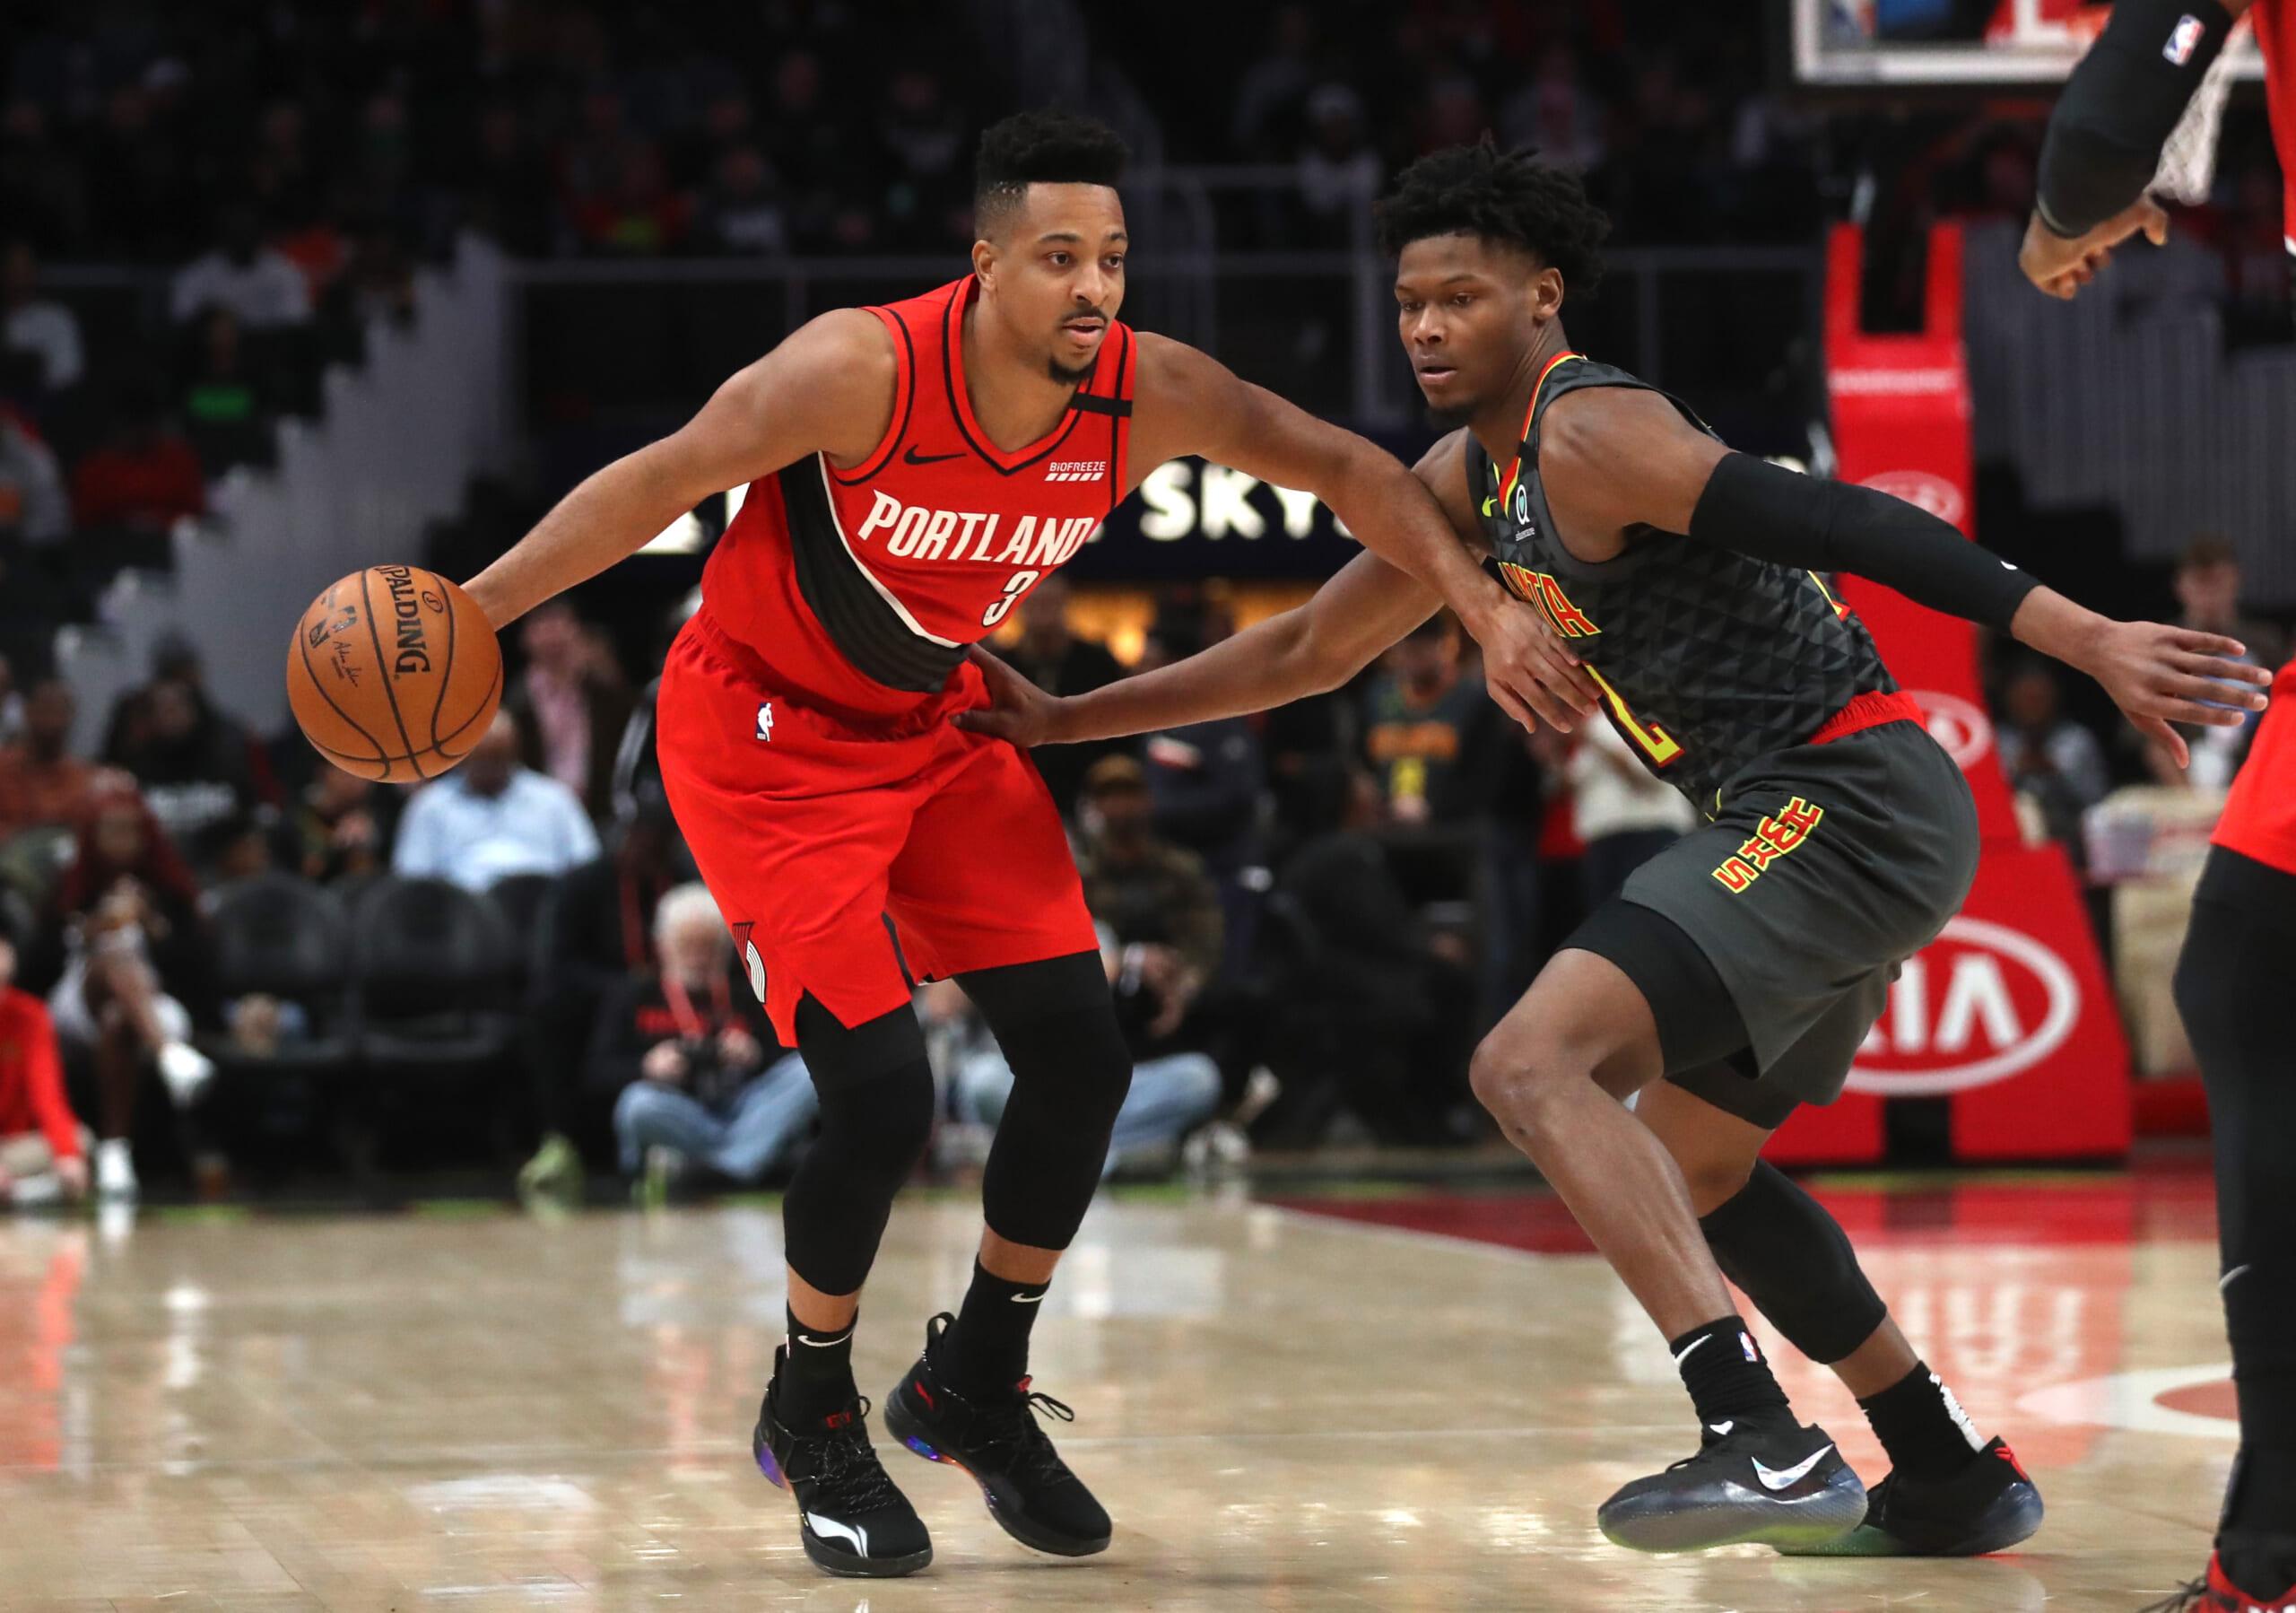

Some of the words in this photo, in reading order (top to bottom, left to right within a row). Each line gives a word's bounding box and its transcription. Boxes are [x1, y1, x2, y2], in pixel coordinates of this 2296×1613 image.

[857, 489, 1095, 567] PORTLAND
[1139, 458, 1356, 541] SKY
[982, 571, 1040, 627] 3
[1862, 953, 2025, 1054] IA
